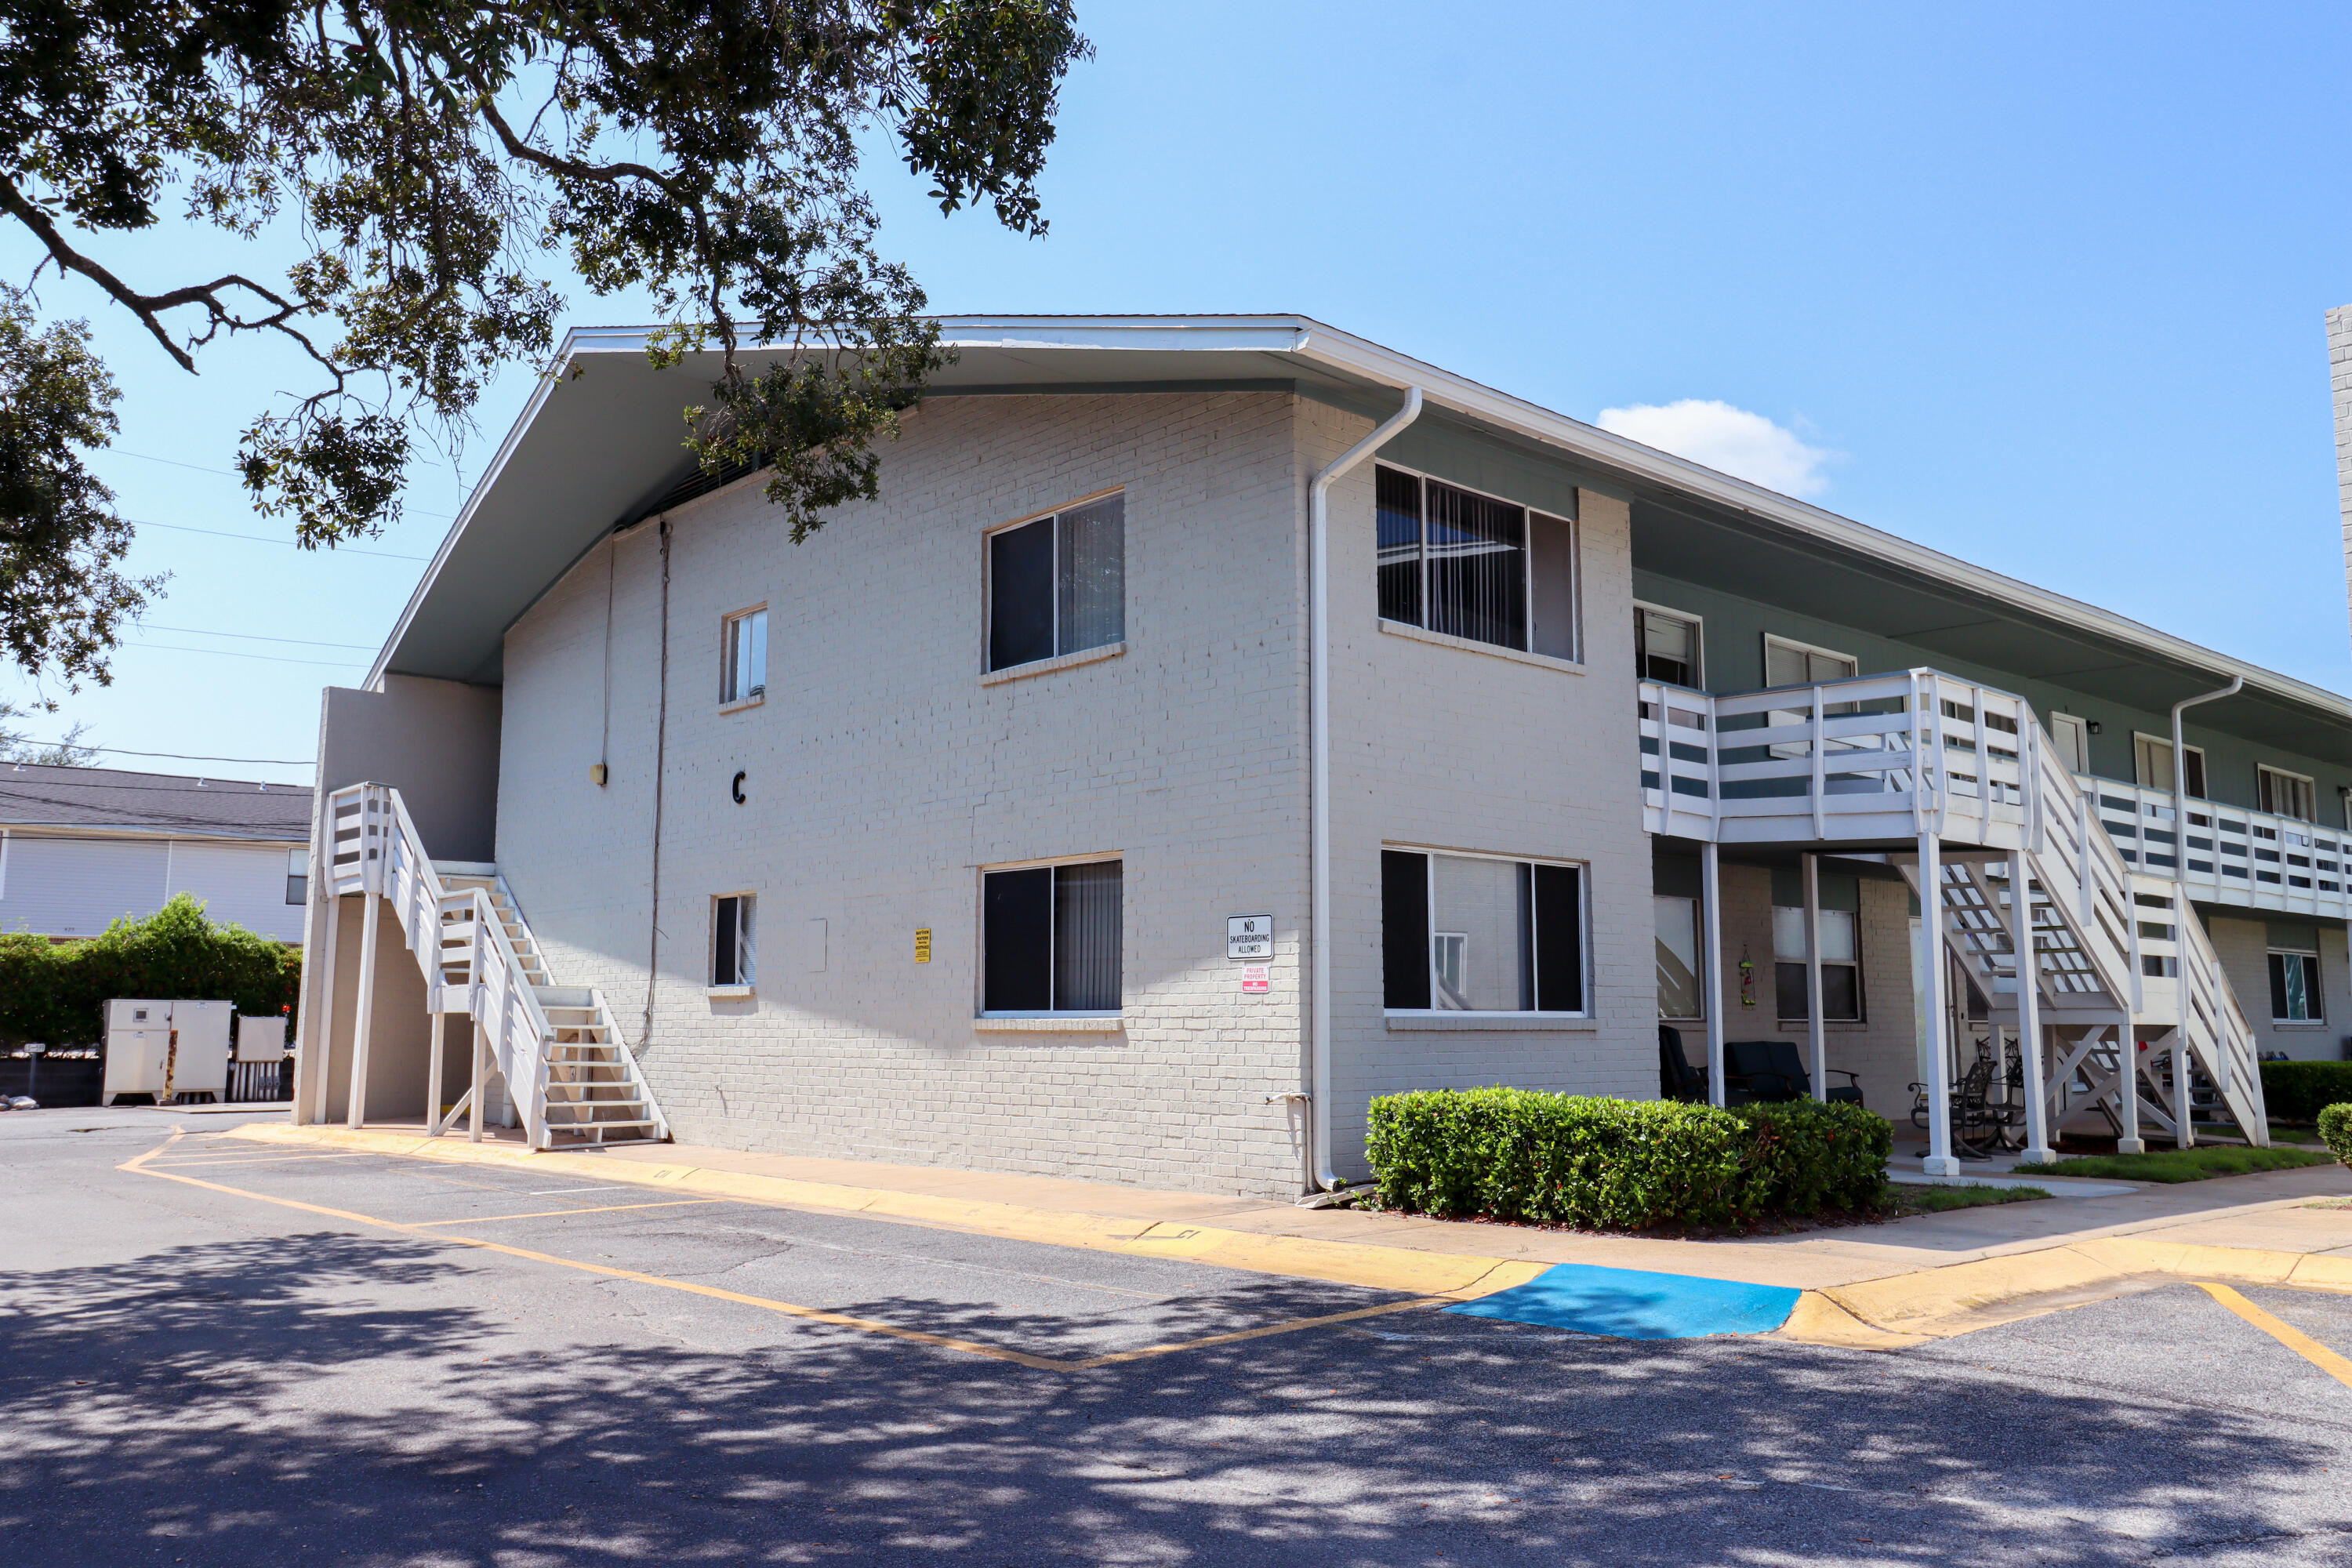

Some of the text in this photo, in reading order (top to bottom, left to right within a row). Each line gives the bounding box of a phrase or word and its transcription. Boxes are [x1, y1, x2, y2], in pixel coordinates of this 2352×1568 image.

[1244, 920, 1254, 932] NO
[1230, 934, 1269, 943] SKATEBOARDING
[1238, 945, 1261, 953] ALLOWED
